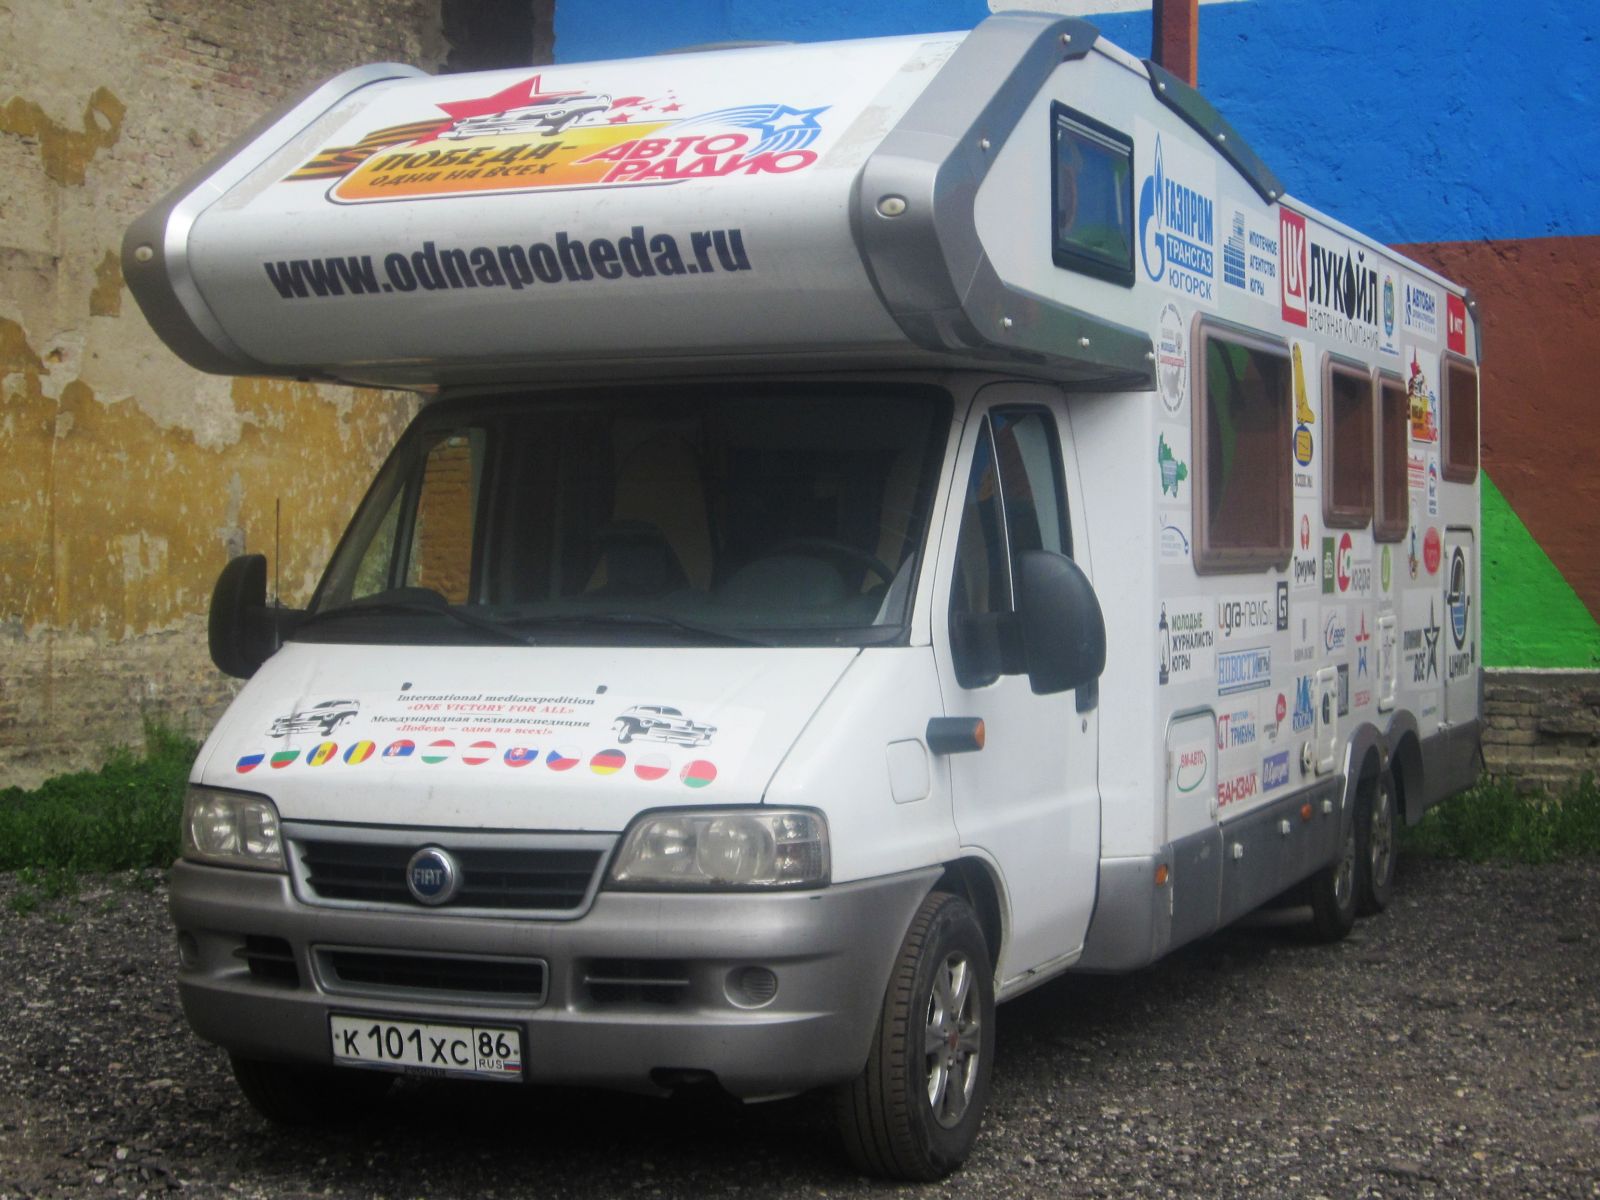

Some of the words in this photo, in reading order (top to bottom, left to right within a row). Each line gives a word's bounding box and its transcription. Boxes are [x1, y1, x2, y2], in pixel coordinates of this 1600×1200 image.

[575, 133, 749, 164] АВТО
[369, 171, 439, 187] ОДНА
[443, 169, 474, 182] НА
[480, 162, 557, 178] ВСЕХ
[600, 150, 818, 184] РАДИО
[1165, 177, 1213, 247] ГАЗПРОМ
[1167, 235, 1213, 273] ТРАНСГАЗ
[1249, 230, 1277, 257] ИПОТЕЧНОЕ
[263, 225, 752, 299] www.odnapobeda.ru
[1249, 254, 1276, 278] АГЕНТСТВО
[1168, 267, 1213, 300] ЮГОРСК
[1249, 277, 1265, 297] ЮГРЫ
[1309, 242, 1378, 326] ЛУКОЙЛ
[1309, 306, 1343, 337] НЕФТЯНАЯ
[1345, 320, 1378, 352] КОМПАНИЯ
[1293, 555, 1317, 583] Триумф
[1171, 612, 1203, 632] МОЛОДЫЕ
[1172, 630, 1214, 653] ЖУРНАЛИСТЫ
[1171, 653, 1191, 673] ЮГРЫ
[1218, 651, 1258, 685] НОВОСТИ
[397, 694, 483, 702] International
[484, 694, 596, 706] mediaexpedition
[446, 703, 504, 713] VICTORY
[508, 705, 536, 713] FOR
[370, 715, 470, 724] Международная
[472, 717, 591, 728] медиаэкспедиция
[1230, 722, 1256, 748] ТРИБУНА
[413, 868, 443, 886] FIAT
[478, 1031, 512, 1059] 86
[479, 1058, 503, 1071] RUS
